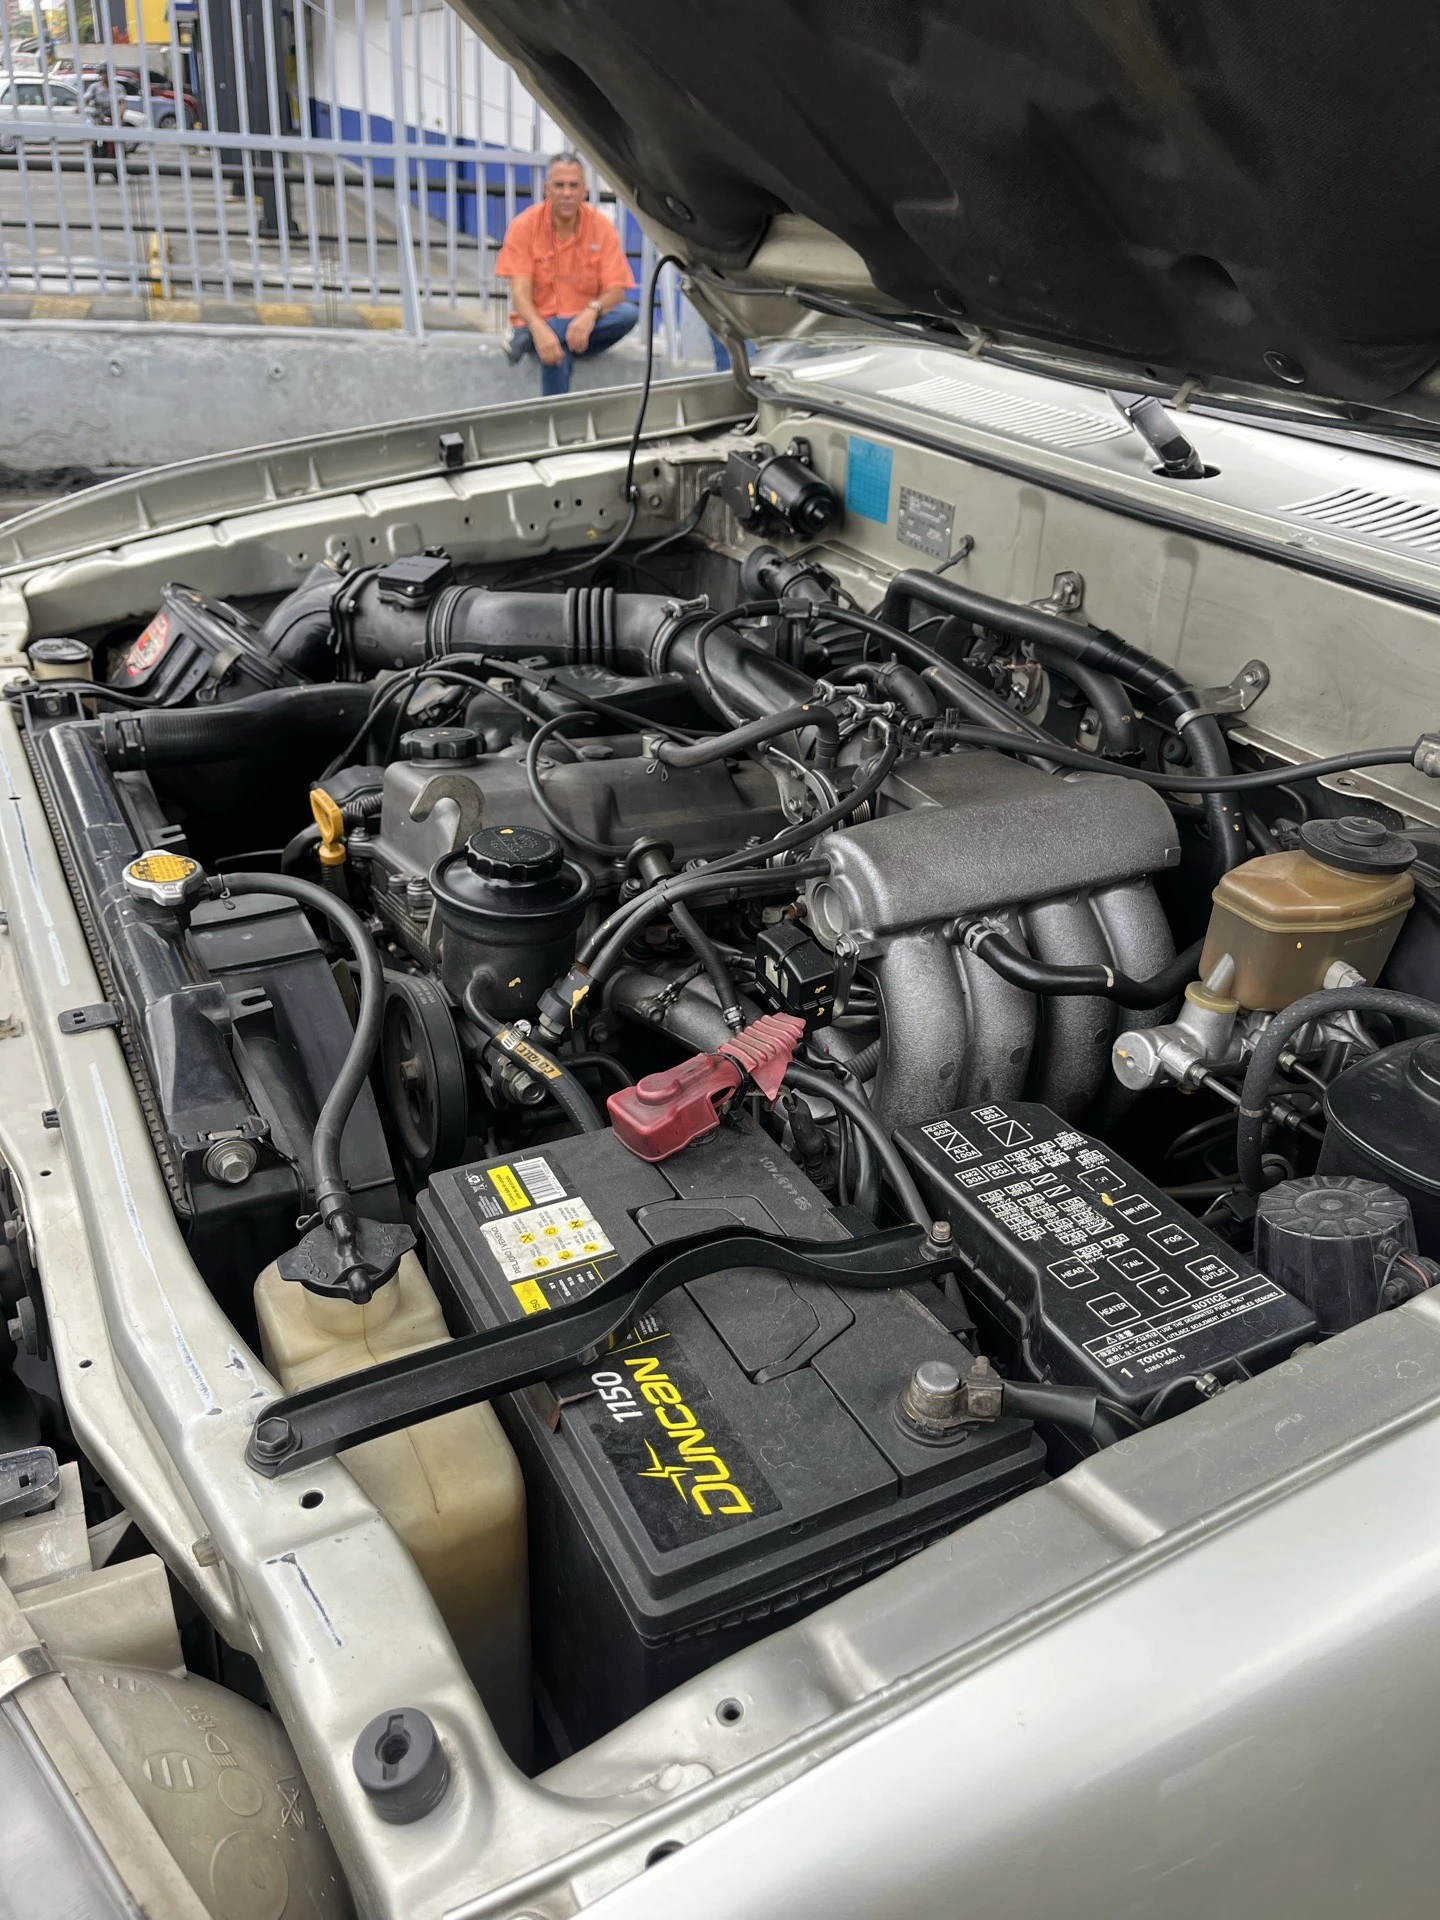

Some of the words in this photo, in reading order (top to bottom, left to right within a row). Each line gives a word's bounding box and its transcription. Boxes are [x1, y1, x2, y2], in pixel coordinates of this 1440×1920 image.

[924, 1122, 950, 1133] HEATER
[933, 1128, 951, 1136] 60A
[953, 1146, 968, 1155] ALT
[956, 1150, 978, 1160] 100A
[1011, 1152, 1027, 1160] 10A
[987, 1163, 1004, 1171] AM1
[1024, 1164, 1040, 1172] 10A
[961, 1171, 979, 1180] AM2
[992, 1168, 1009, 1176] 50A
[966, 1176, 984, 1184] 30A
[1009, 1184, 1027, 1192] 20A
[984, 1192, 1001, 1200] 10A
[1025, 1197, 1042, 1205] 15A
[1064, 1200, 1081, 1208] 10A
[1134, 1203, 1150, 1211] HTR
[1039, 1209, 1055, 1217] 15A
[1052, 1221, 1069, 1229] 10A
[491, 1227, 507, 1248] VENENO
[1106, 1237, 1126, 1246] 7.5A
[1163, 1234, 1182, 1244] FOG
[1080, 1247, 1098, 1256] 20A
[504, 1250, 522, 1274] PELIGRO
[1122, 1260, 1144, 1269] TAIL
[1060, 1267, 1085, 1278] HEAD
[1200, 1264, 1217, 1273] PWR
[1201, 1267, 1228, 1281] OUTLET
[1157, 1286, 1169, 1294] ST
[1191, 1293, 1227, 1310] NOTICE
[1099, 1302, 1128, 1316] HEATER
[1184, 1309, 1214, 1324] DESIGNATED
[1214, 1302, 1231, 1311] FUSES
[1231, 1296, 1245, 1304] ONLY
[1167, 1327, 1191, 1339] UTILISEZ
[1137, 1347, 1177, 1366] TOYOTA
[1120, 1368, 1134, 1378] 1
[593, 1372, 643, 1423] 1150
[624, 1357, 753, 1516] DUNCAN
